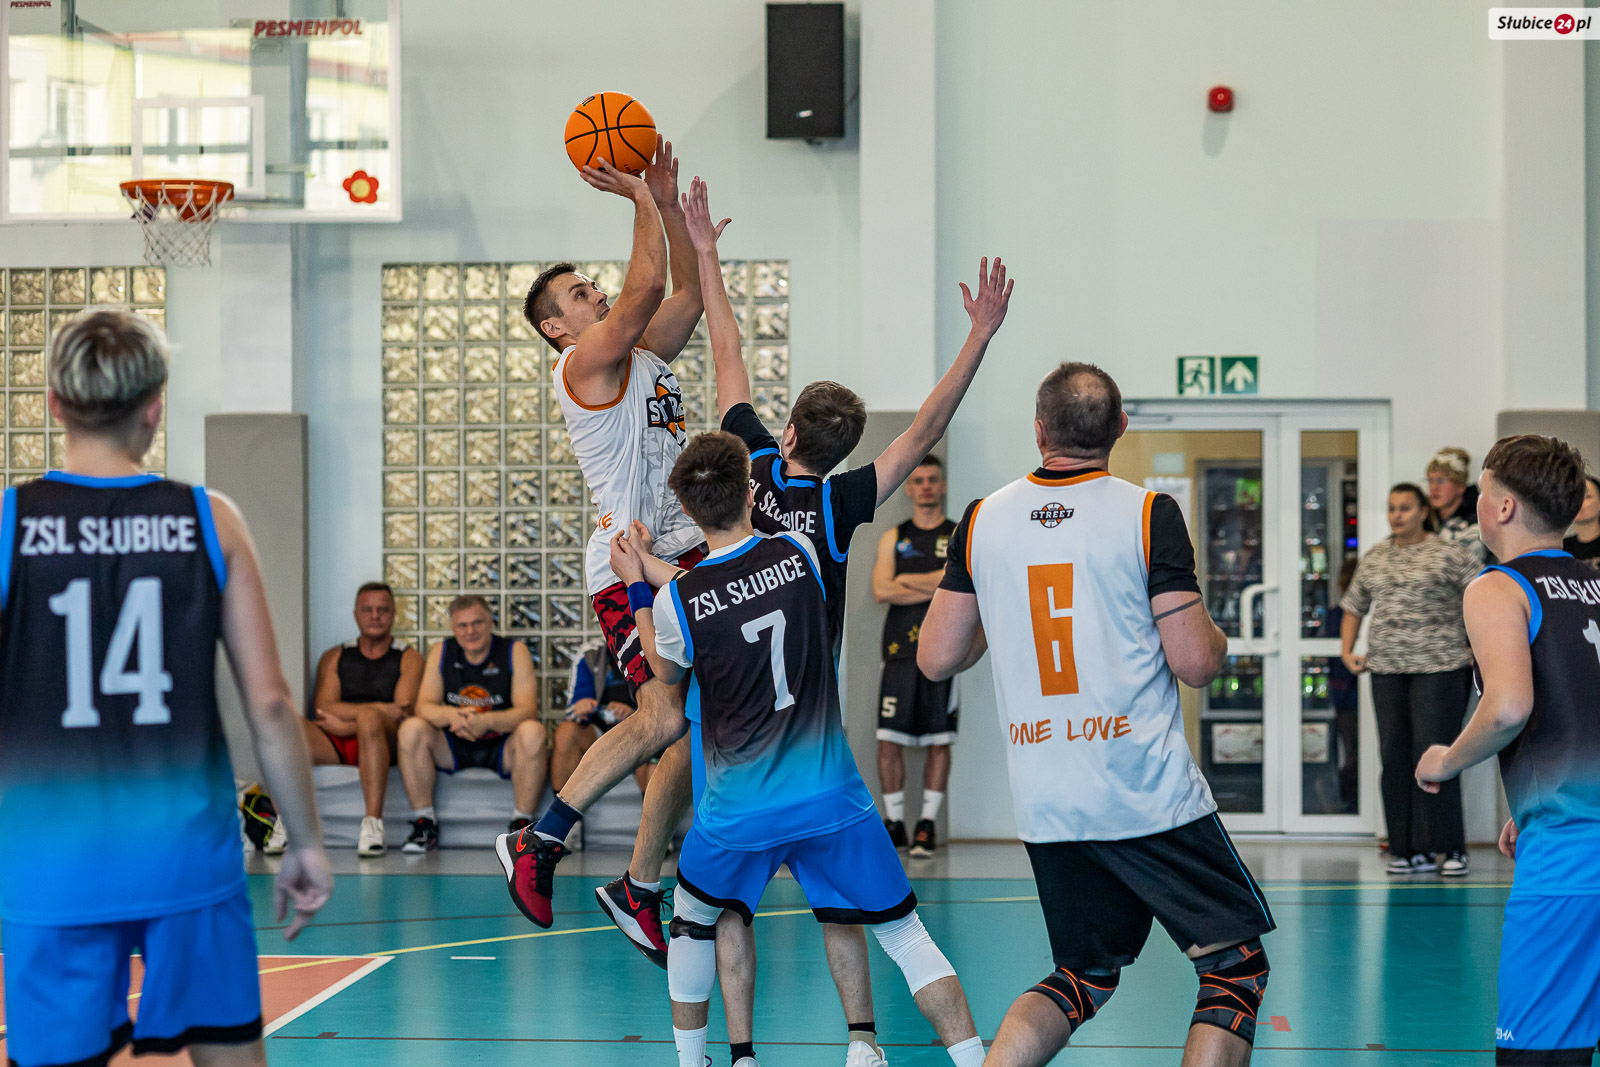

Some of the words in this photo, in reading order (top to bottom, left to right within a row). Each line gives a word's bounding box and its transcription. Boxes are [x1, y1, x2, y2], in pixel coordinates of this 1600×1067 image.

[254, 19, 362, 37] PESMENPOL
[759, 490, 817, 534] SŁUBICE
[1032, 509, 1073, 519] STREET
[20, 515, 76, 556] ZSL
[78, 514, 197, 555] SŁUBICE
[935, 536, 949, 558] 5
[688, 589, 729, 622] ZSL
[726, 554, 806, 605] SŁUBICE
[1535, 575, 1578, 600] ZSL
[1027, 562, 1080, 696] 6
[48, 576, 174, 729] 14
[740, 609, 796, 712] 7
[881, 696, 898, 719] 5
[1009, 719, 1052, 746] ONE
[1067, 715, 1132, 742] LOVE
